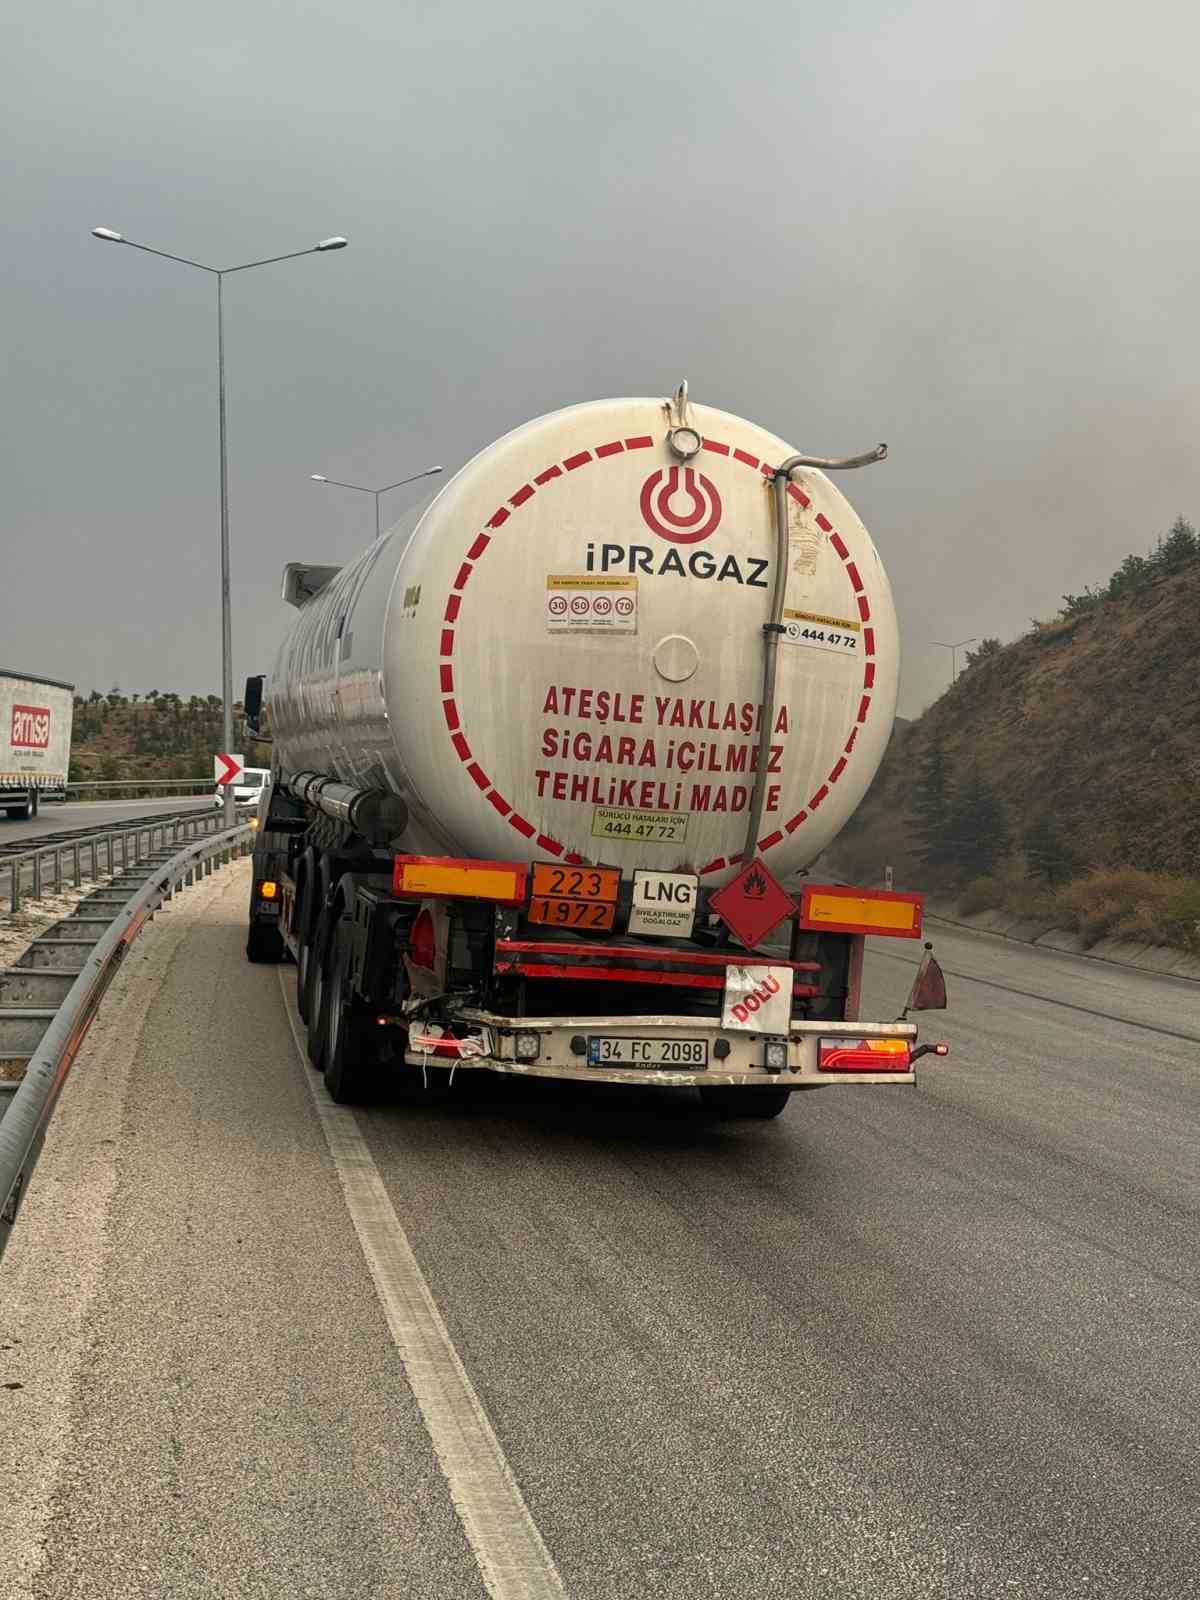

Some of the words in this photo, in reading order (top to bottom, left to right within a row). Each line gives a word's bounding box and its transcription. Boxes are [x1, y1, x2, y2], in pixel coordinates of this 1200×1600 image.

[552, 601, 564, 610] 30
[574, 601, 587, 610] 50
[596, 601, 609, 610] 60
[619, 602, 631, 610] 70
[801, 628, 825, 641] 444
[827, 633, 842, 645] 47
[843, 636, 856, 648] 72
[543, 686, 645, 725] ATEŞLE
[690, 784, 781, 812] MADE
[604, 822, 632, 835] 444
[636, 825, 654, 837] 47
[658, 826, 676, 839] 72
[549, 870, 602, 897] 223
[643, 880, 691, 904] LNG
[541, 900, 608, 926] 1972
[731, 974, 781, 1023] DOLU
[602, 1041, 622, 1059] 34
[631, 1042, 652, 1060] FC
[661, 1043, 703, 1062] 2098
